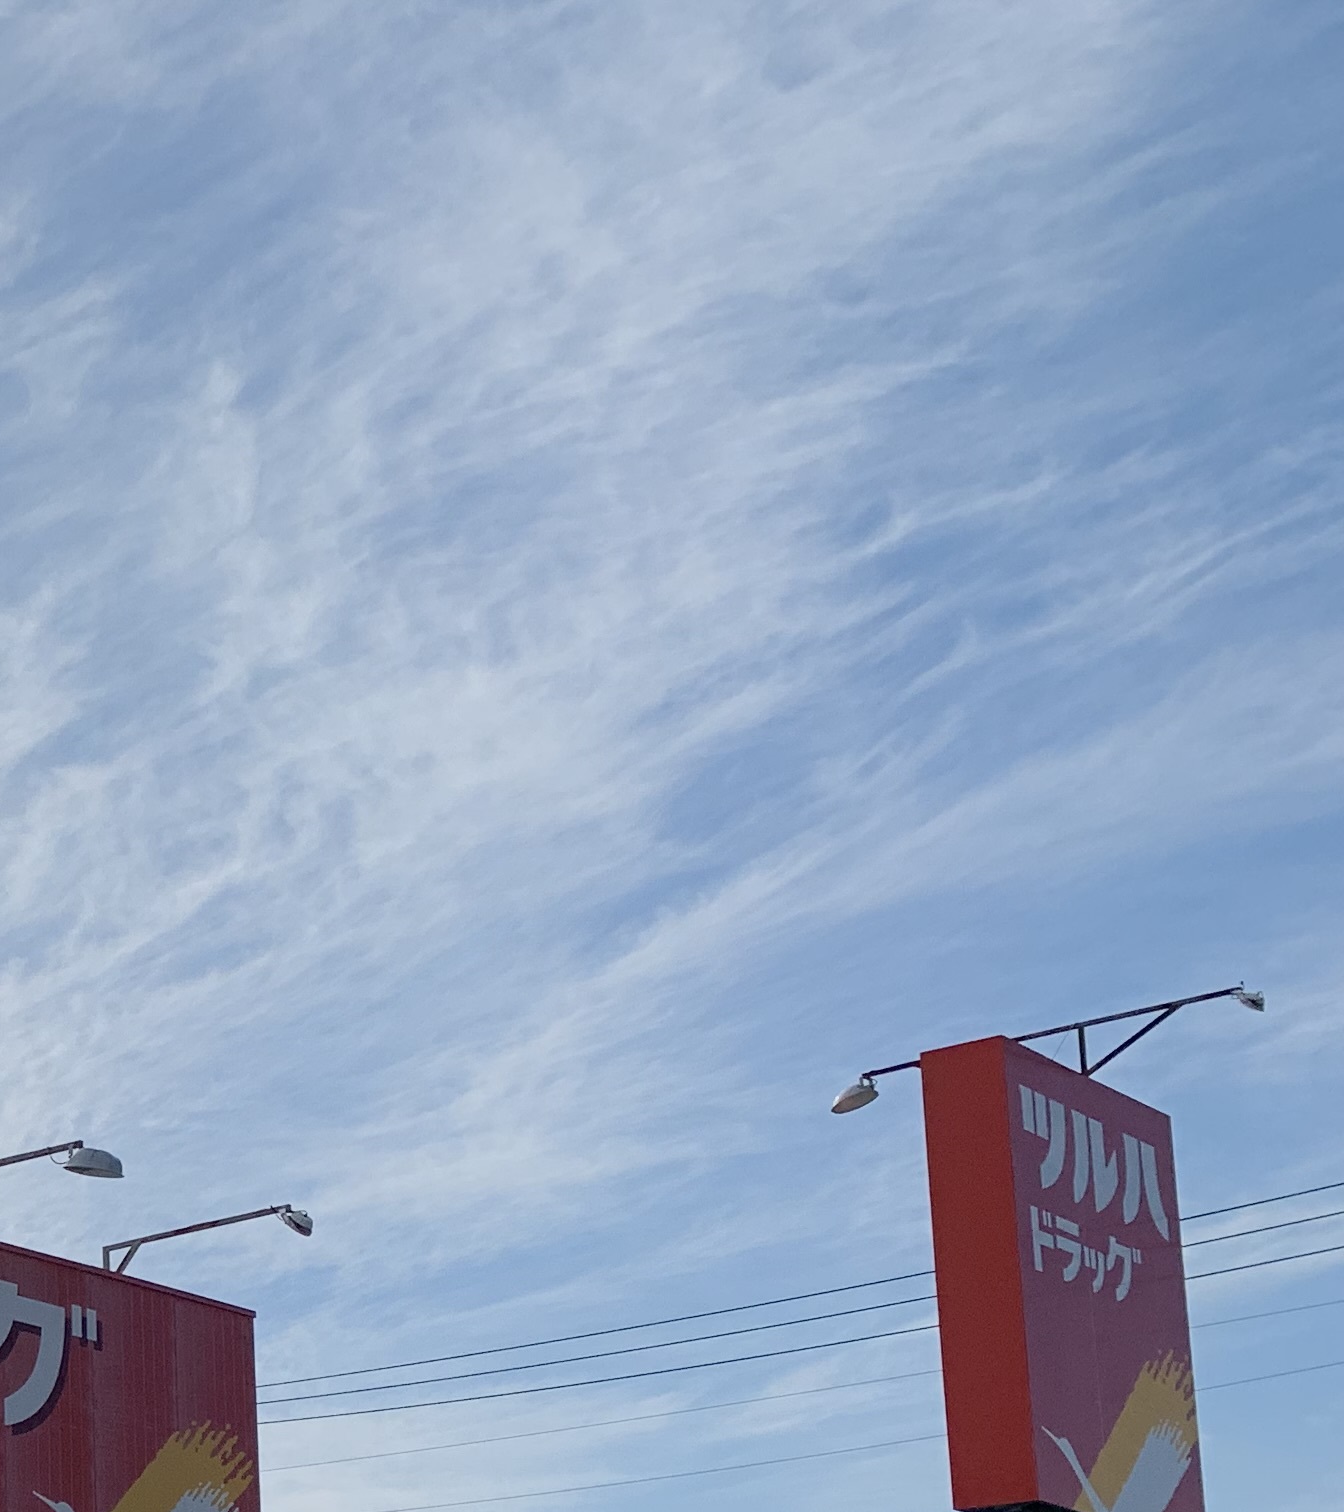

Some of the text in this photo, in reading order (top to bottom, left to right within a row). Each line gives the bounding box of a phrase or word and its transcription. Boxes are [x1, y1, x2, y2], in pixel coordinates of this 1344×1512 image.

[1018, 1084, 1170, 1241] ツルハ
[1029, 1205, 1142, 1302] ドラッグ
